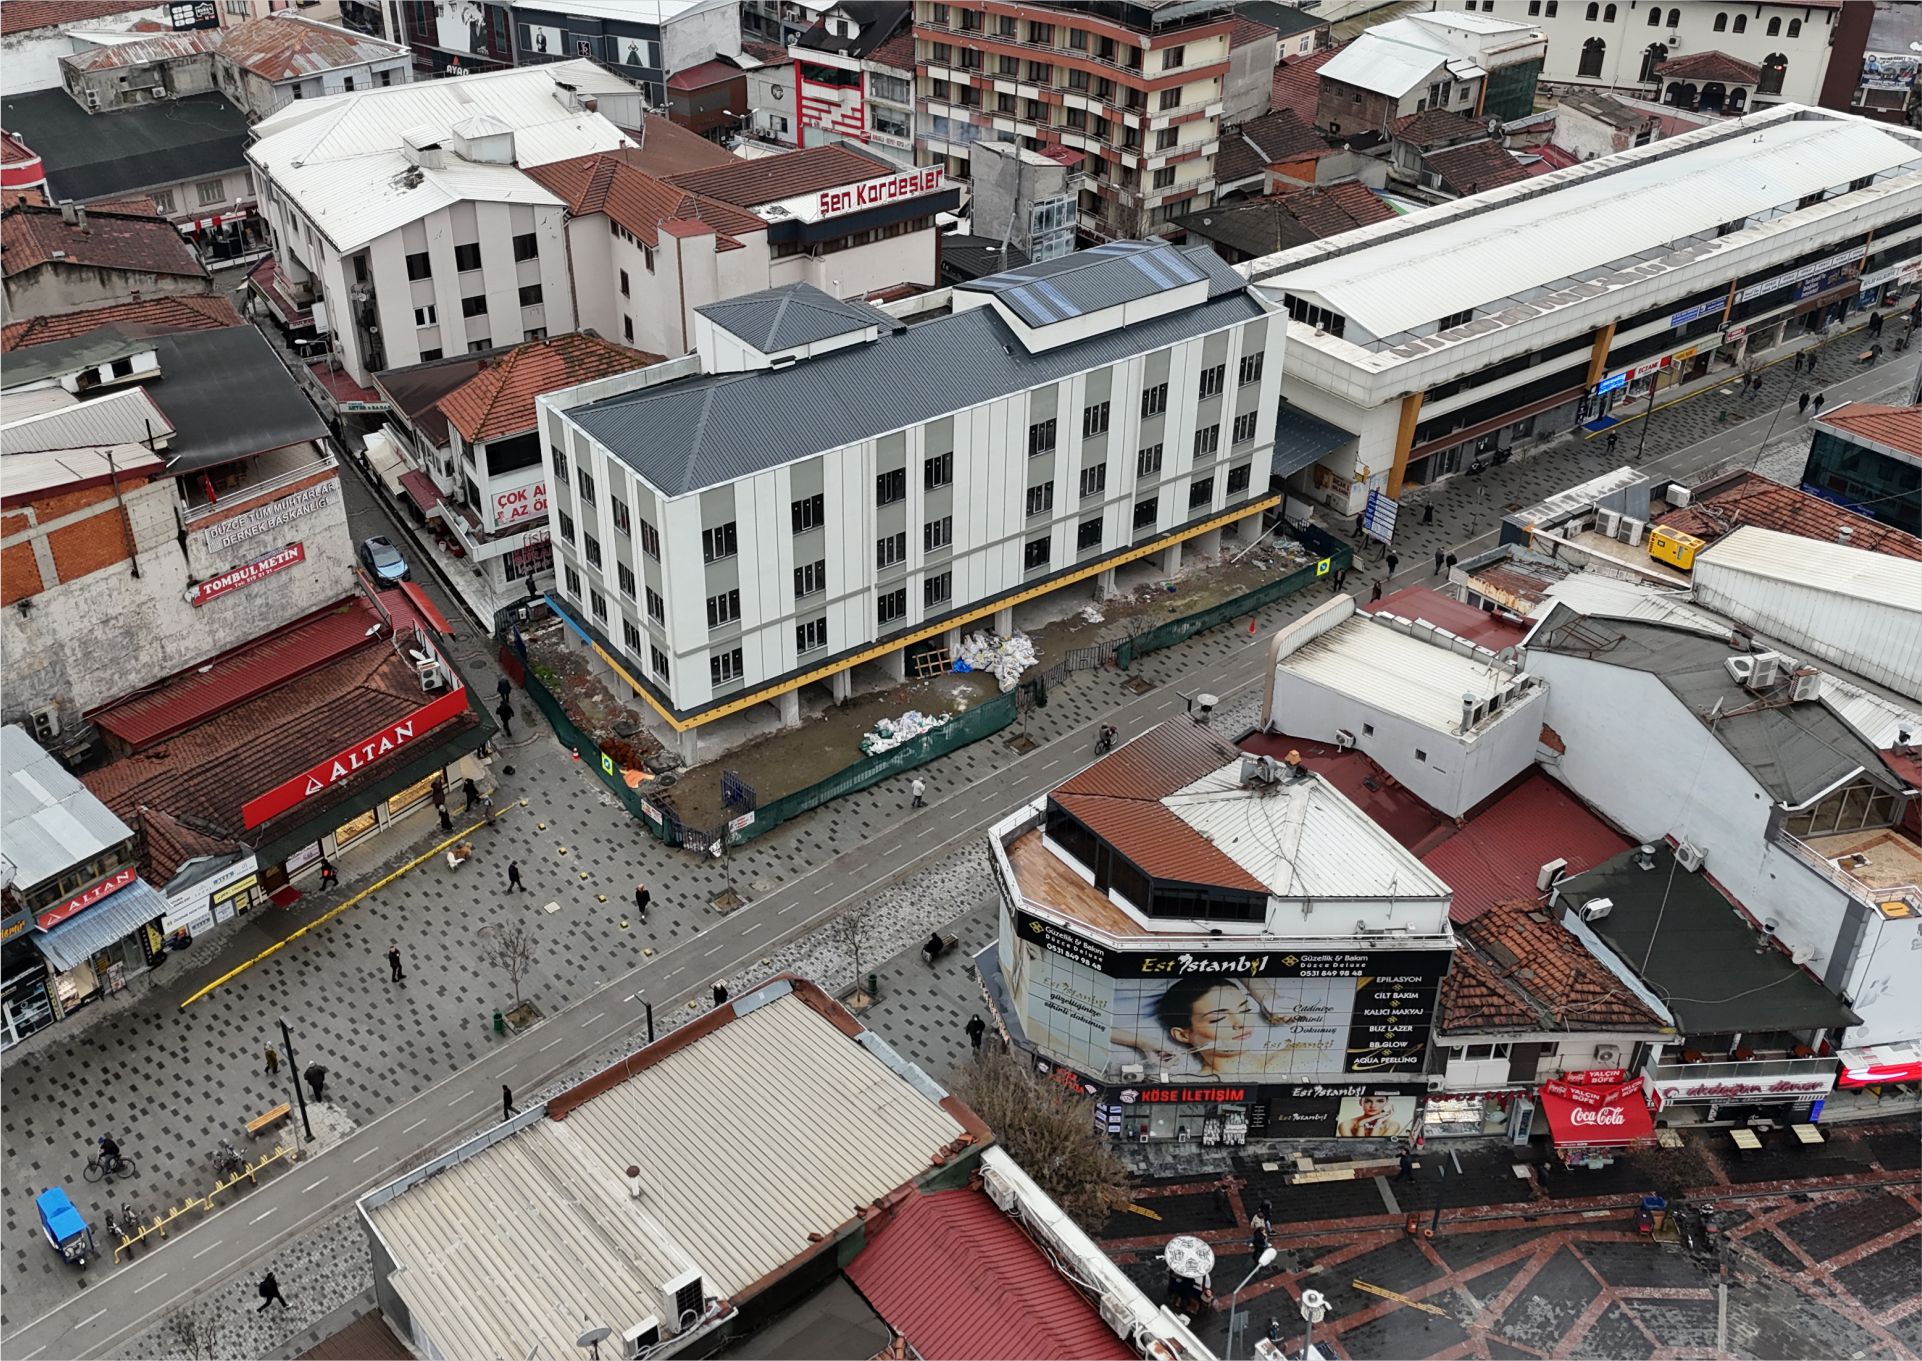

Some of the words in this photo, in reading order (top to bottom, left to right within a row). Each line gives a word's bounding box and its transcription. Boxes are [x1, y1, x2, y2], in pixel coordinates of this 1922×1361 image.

[272, 482, 336, 514] MUHTARLAR
[497, 489, 527, 509] ÇOK
[511, 504, 529, 519] AZ
[222, 523, 267, 547] DERNEK
[203, 565, 258, 595] TOMBUL
[330, 720, 414, 782] ALTAN
[68, 871, 129, 912] ALTAN
[1045, 926, 1074, 943] Güzellik
[1074, 938, 1082, 946] &
[1046, 943, 1064, 955] 0531
[1065, 950, 1080, 961] 849
[1080, 956, 1091, 966] 98
[1091, 960, 1102, 971] 48
[1141, 958, 1176, 972] Est
[1300, 954, 1333, 962] Güzellik
[1334, 954, 1343, 962] &
[1141, 1088, 1179, 1102] KÖSE
[1181, 1087, 1245, 1103] İLETİŞİM
[1292, 1087, 1313, 1097] Est
